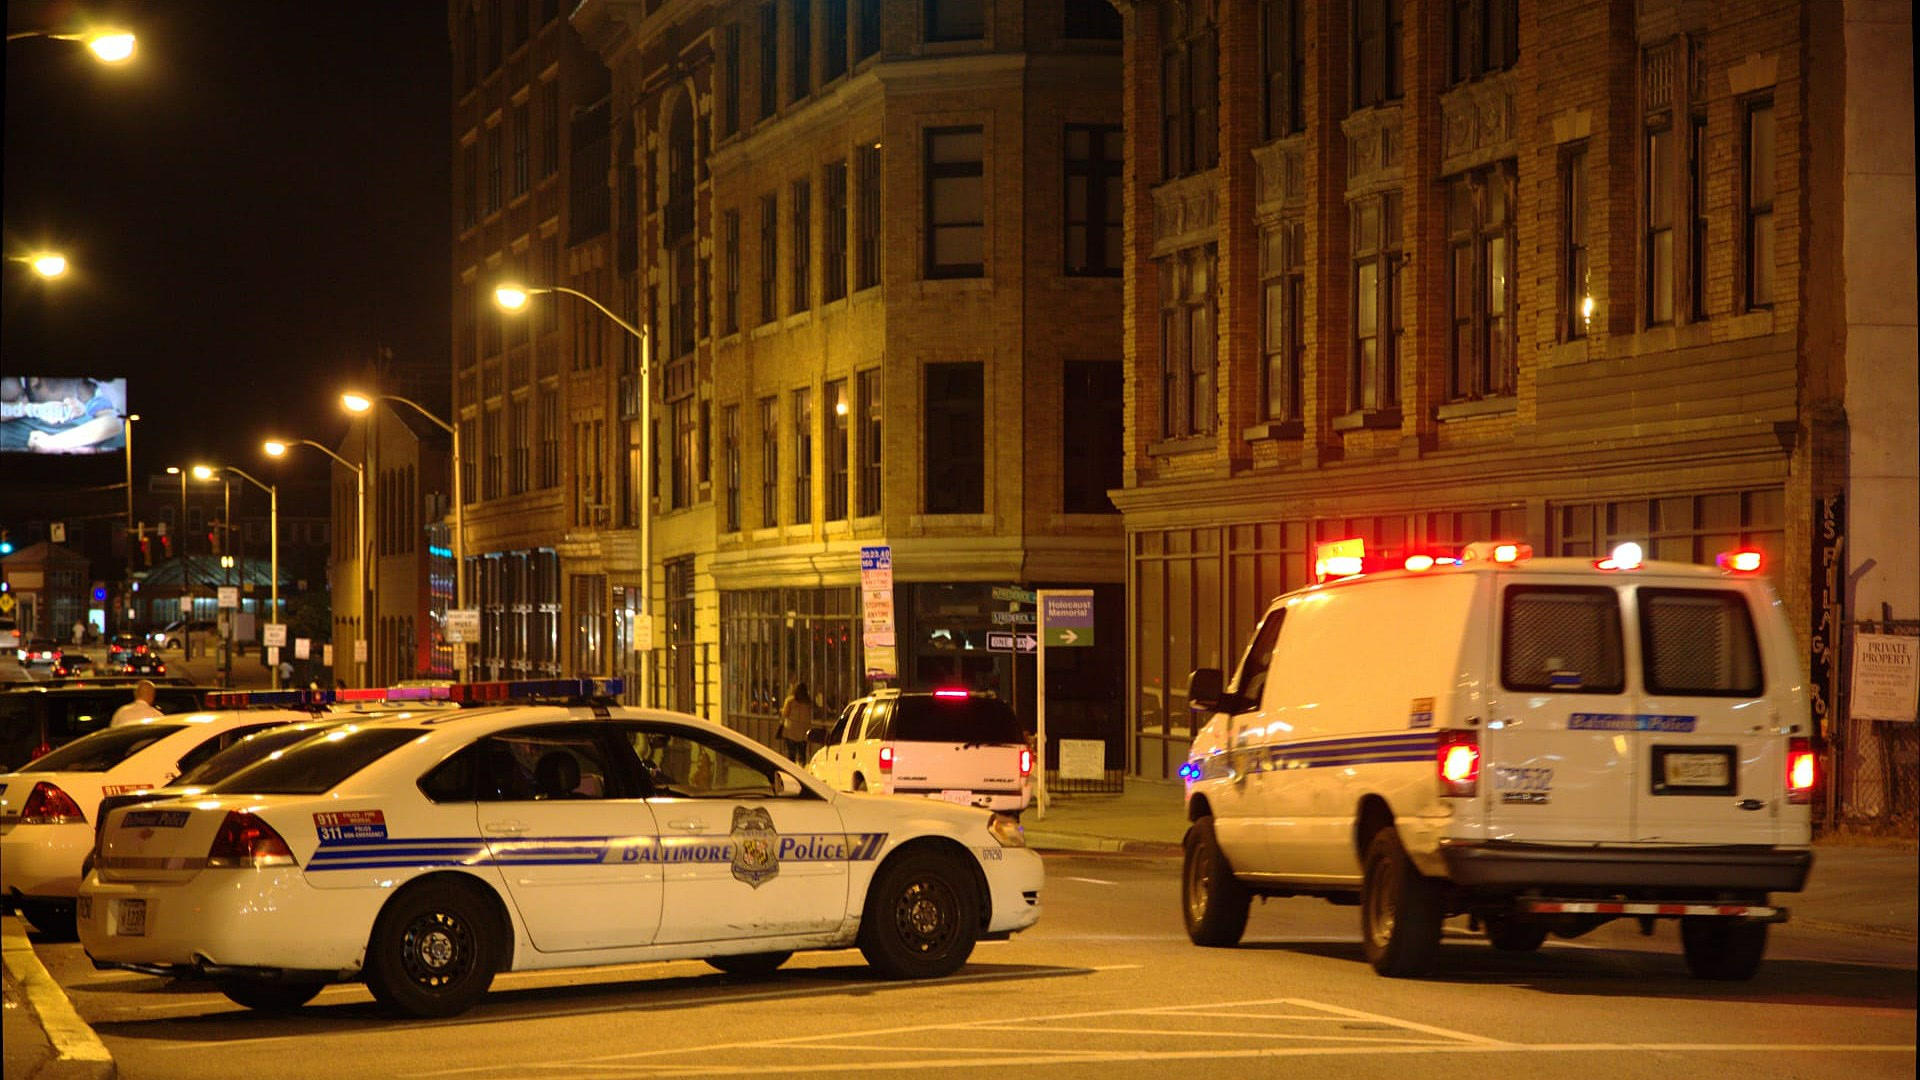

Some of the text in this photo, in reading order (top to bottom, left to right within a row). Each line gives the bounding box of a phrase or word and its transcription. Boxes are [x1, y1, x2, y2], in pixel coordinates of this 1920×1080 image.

[1048, 601, 1091, 609] Holocaust
[1048, 609, 1088, 617] Memorial
[992, 637, 1008, 646] ONE
[1868, 642, 1907, 654] PRIVATE
[1862, 653, 1912, 665] PROPERTY
[317, 813, 338, 825] 911
[321, 826, 343, 840] 311
[778, 836, 845, 860] Police
